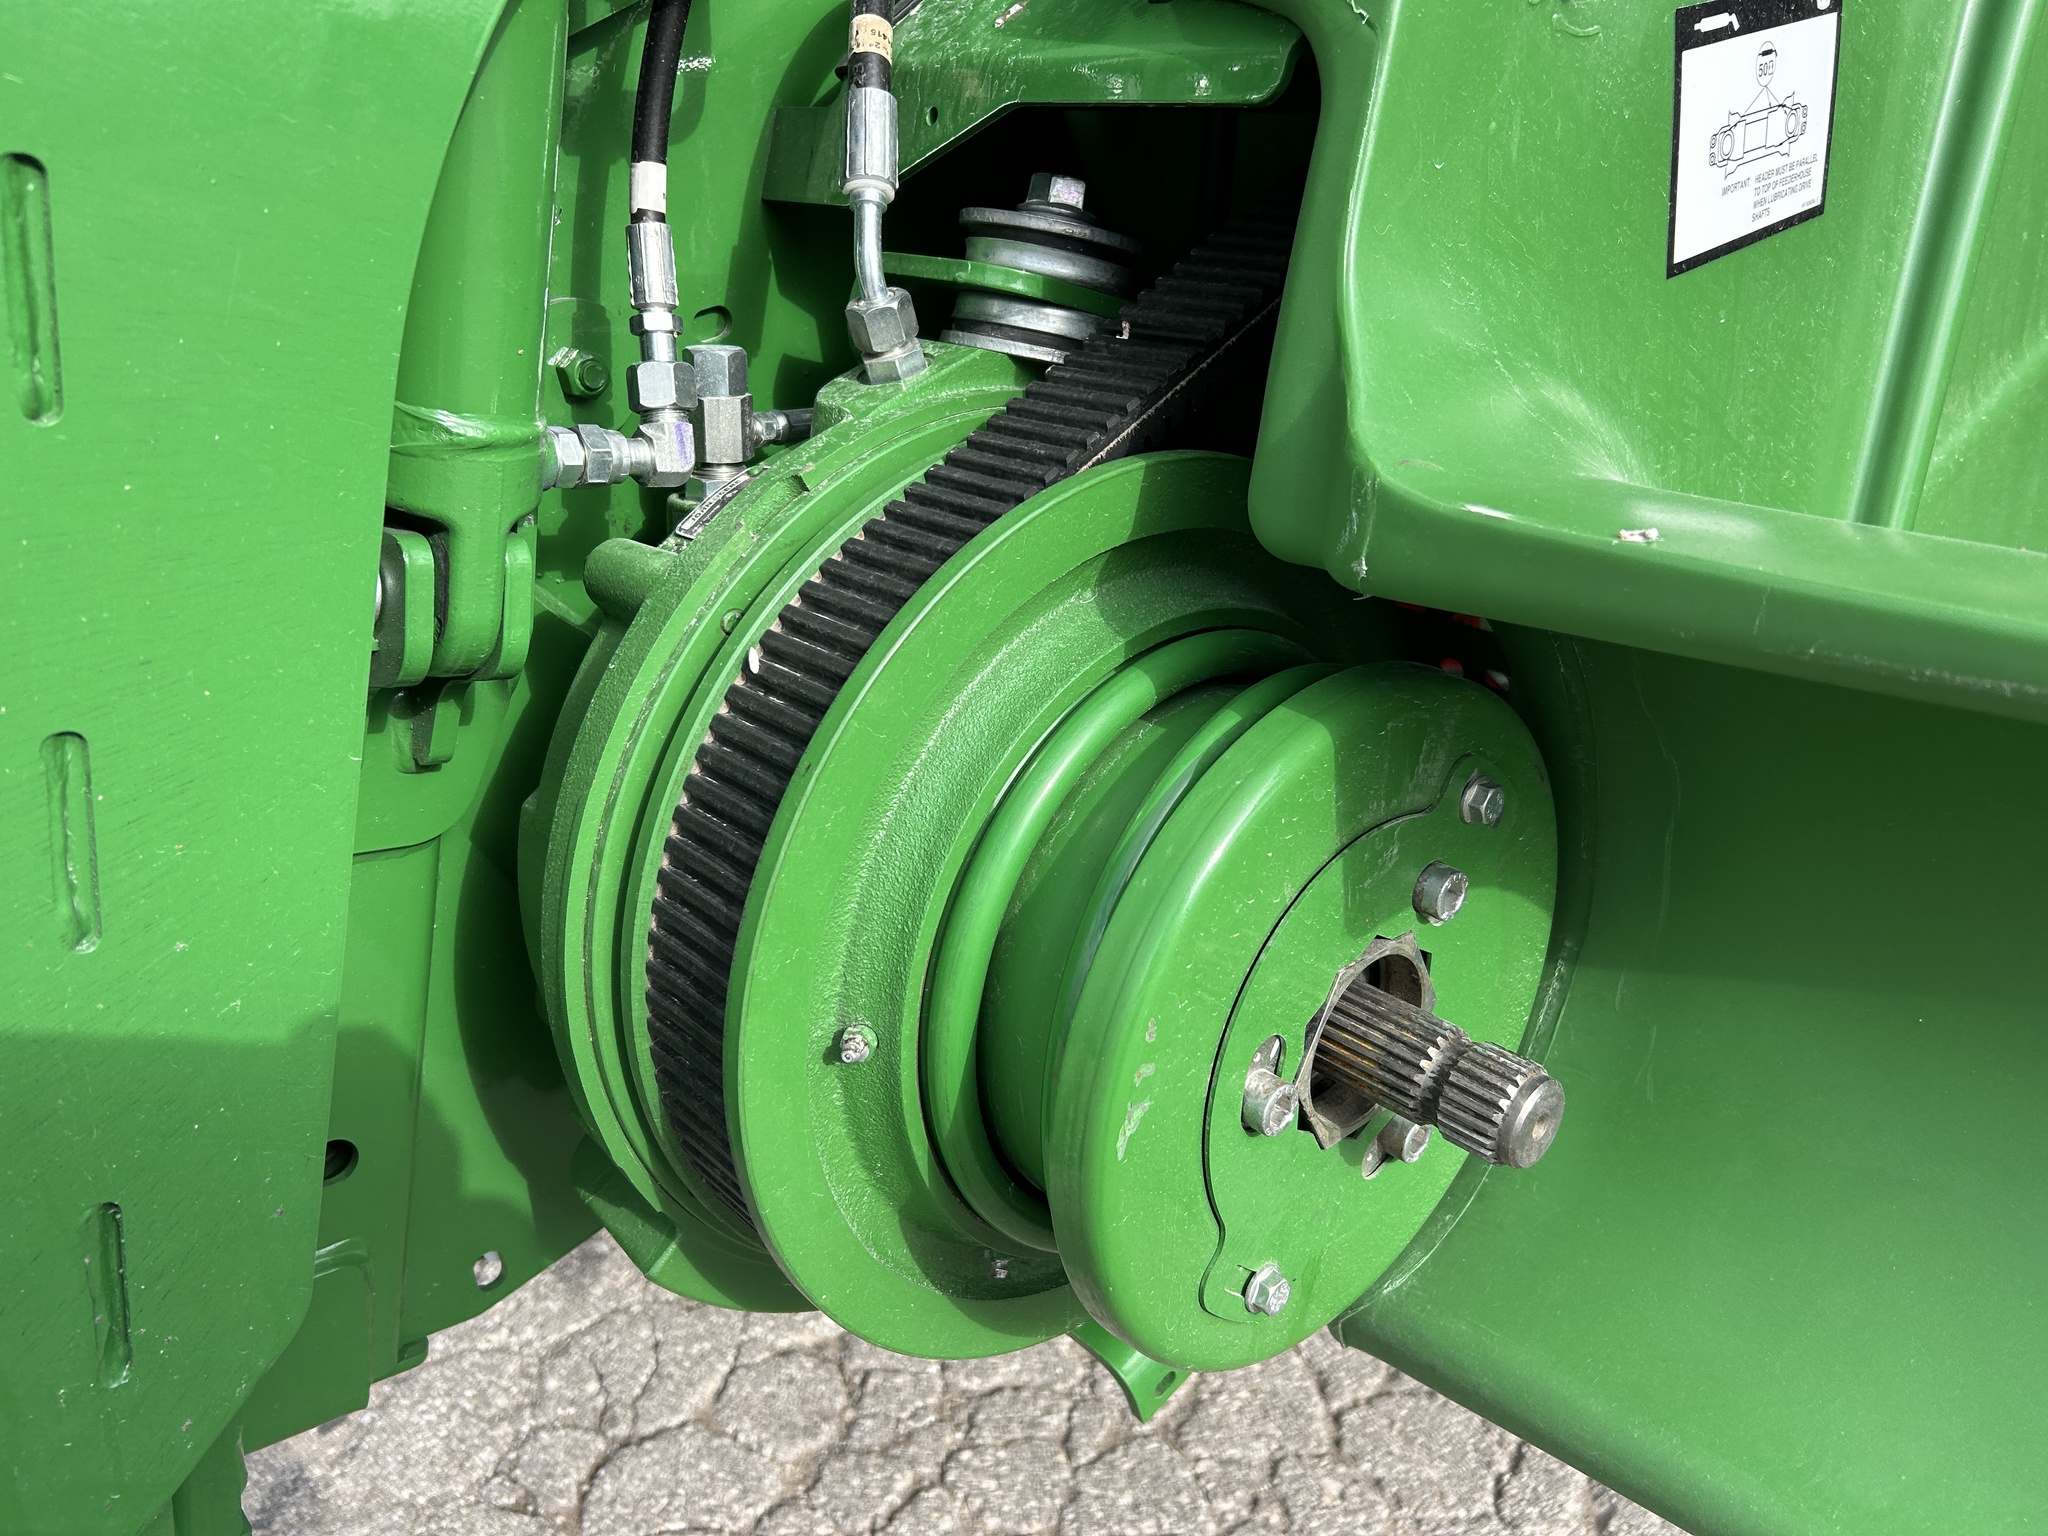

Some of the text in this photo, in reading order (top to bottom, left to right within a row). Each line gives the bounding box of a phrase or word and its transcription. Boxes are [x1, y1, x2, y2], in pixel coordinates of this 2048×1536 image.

[1758, 62, 1768, 77] 50
[1721, 153, 1818, 196] IMPORTANT: HEADER MUST BE PARALLEL
[1754, 166, 1812, 196] TO TOP OF FEEDERHOUSE
[1753, 196, 1767, 210] WHEN
[1767, 184, 1798, 204] LUBRICATING
[1799, 178, 1812, 192] DRIVE
[1751, 207, 1771, 222] SHAFTS
[691, 501, 713, 522] JOHN
